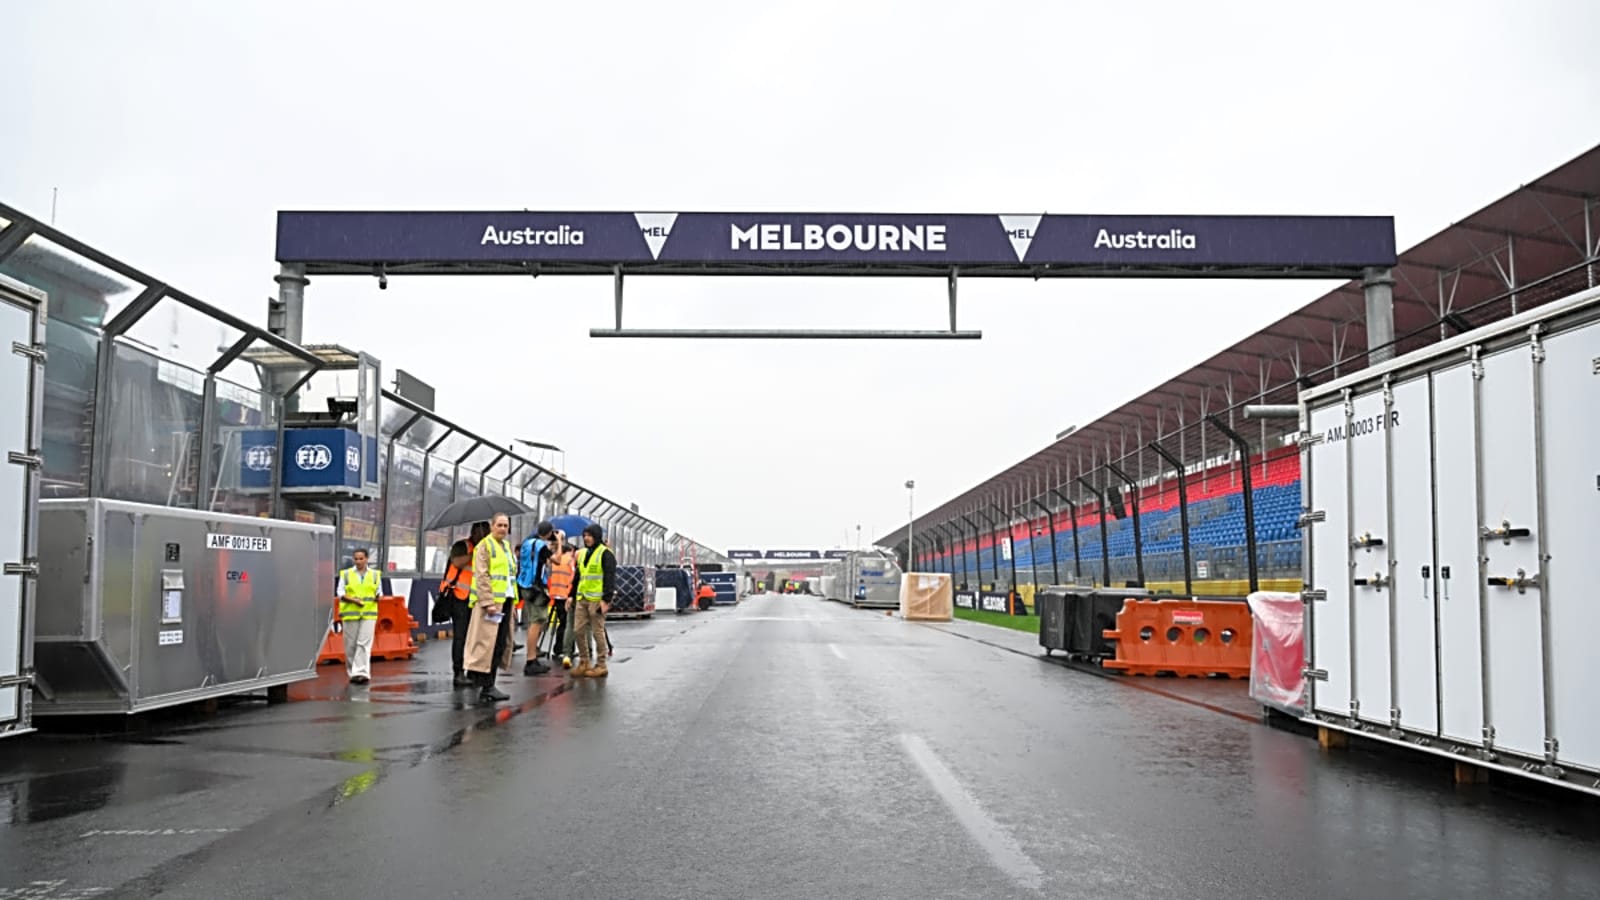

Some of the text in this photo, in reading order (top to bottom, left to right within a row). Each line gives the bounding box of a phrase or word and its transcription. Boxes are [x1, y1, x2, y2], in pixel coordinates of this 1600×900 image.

[481, 225, 584, 245] Australia
[642, 226, 671, 237] MEL
[730, 223, 948, 252] MELBOURNE
[1006, 229, 1035, 240] MEL
[1093, 229, 1197, 250] Australia
[300, 448, 328, 466] FIA
[346, 450, 359, 468] FIA
[211, 535, 268, 551] AMF 0013 FER
